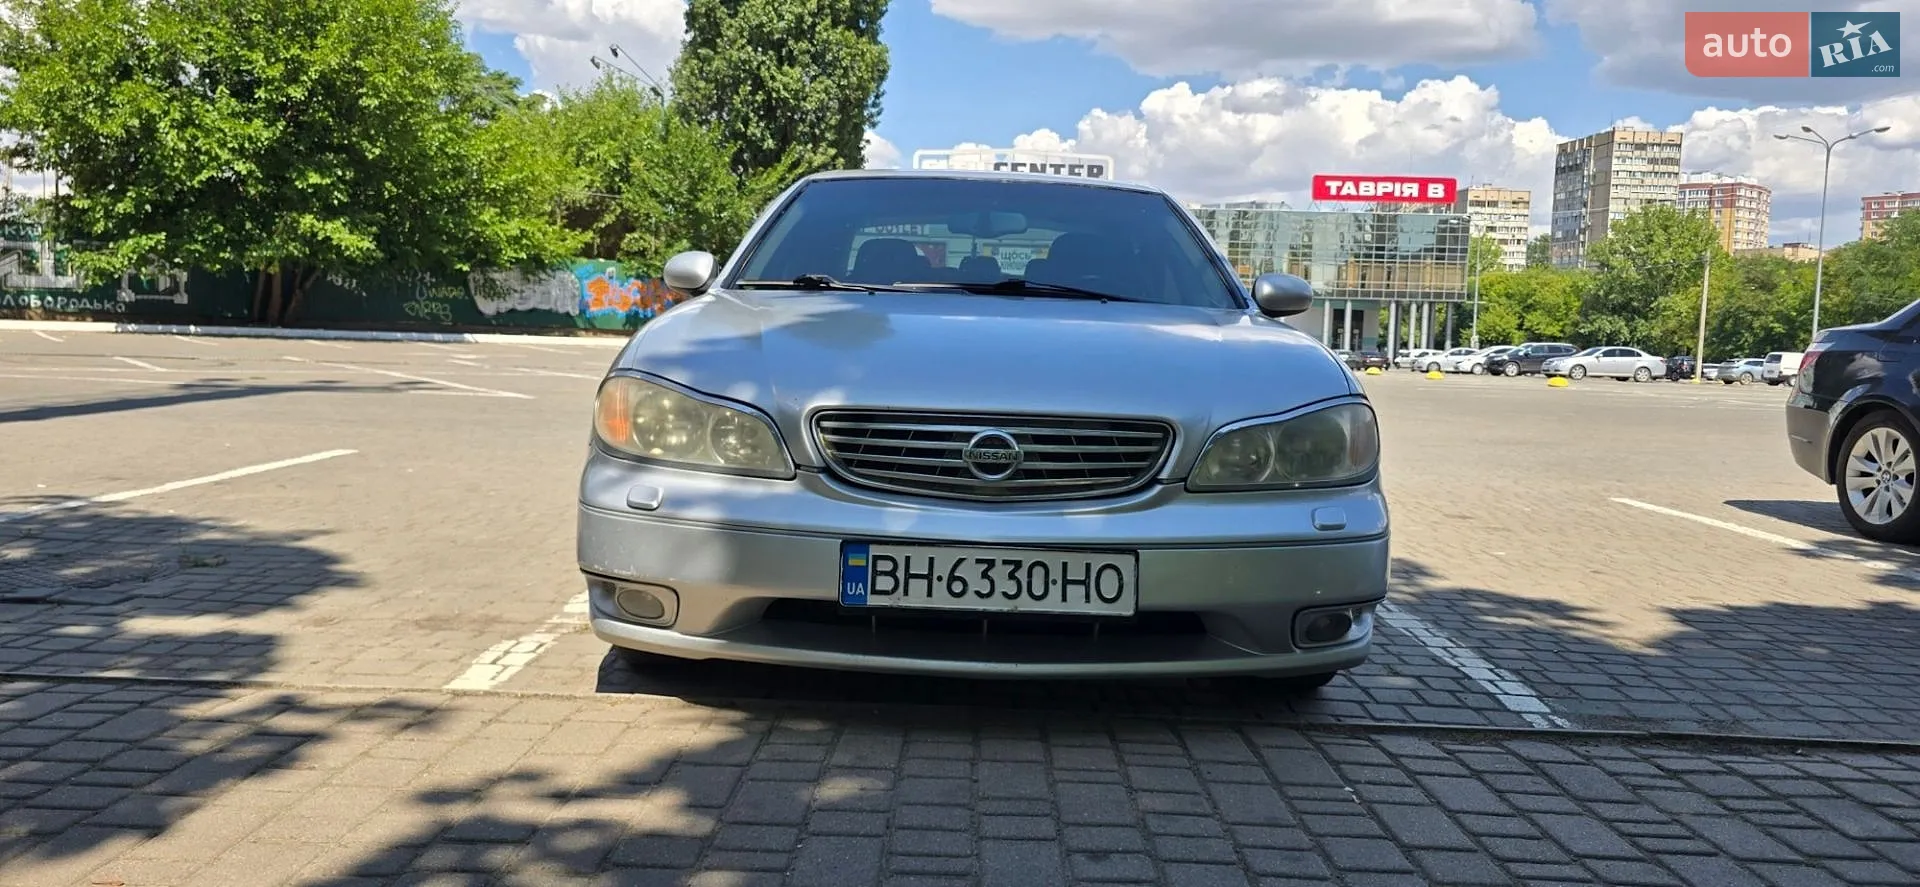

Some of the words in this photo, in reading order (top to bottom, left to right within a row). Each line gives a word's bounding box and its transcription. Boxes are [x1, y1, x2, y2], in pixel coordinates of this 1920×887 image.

[1325, 180, 1419, 198] ТАВРІЯ
[1427, 183, 1445, 198] В
[968, 451, 1018, 461] NISSAN
[847, 582, 865, 596] UA
